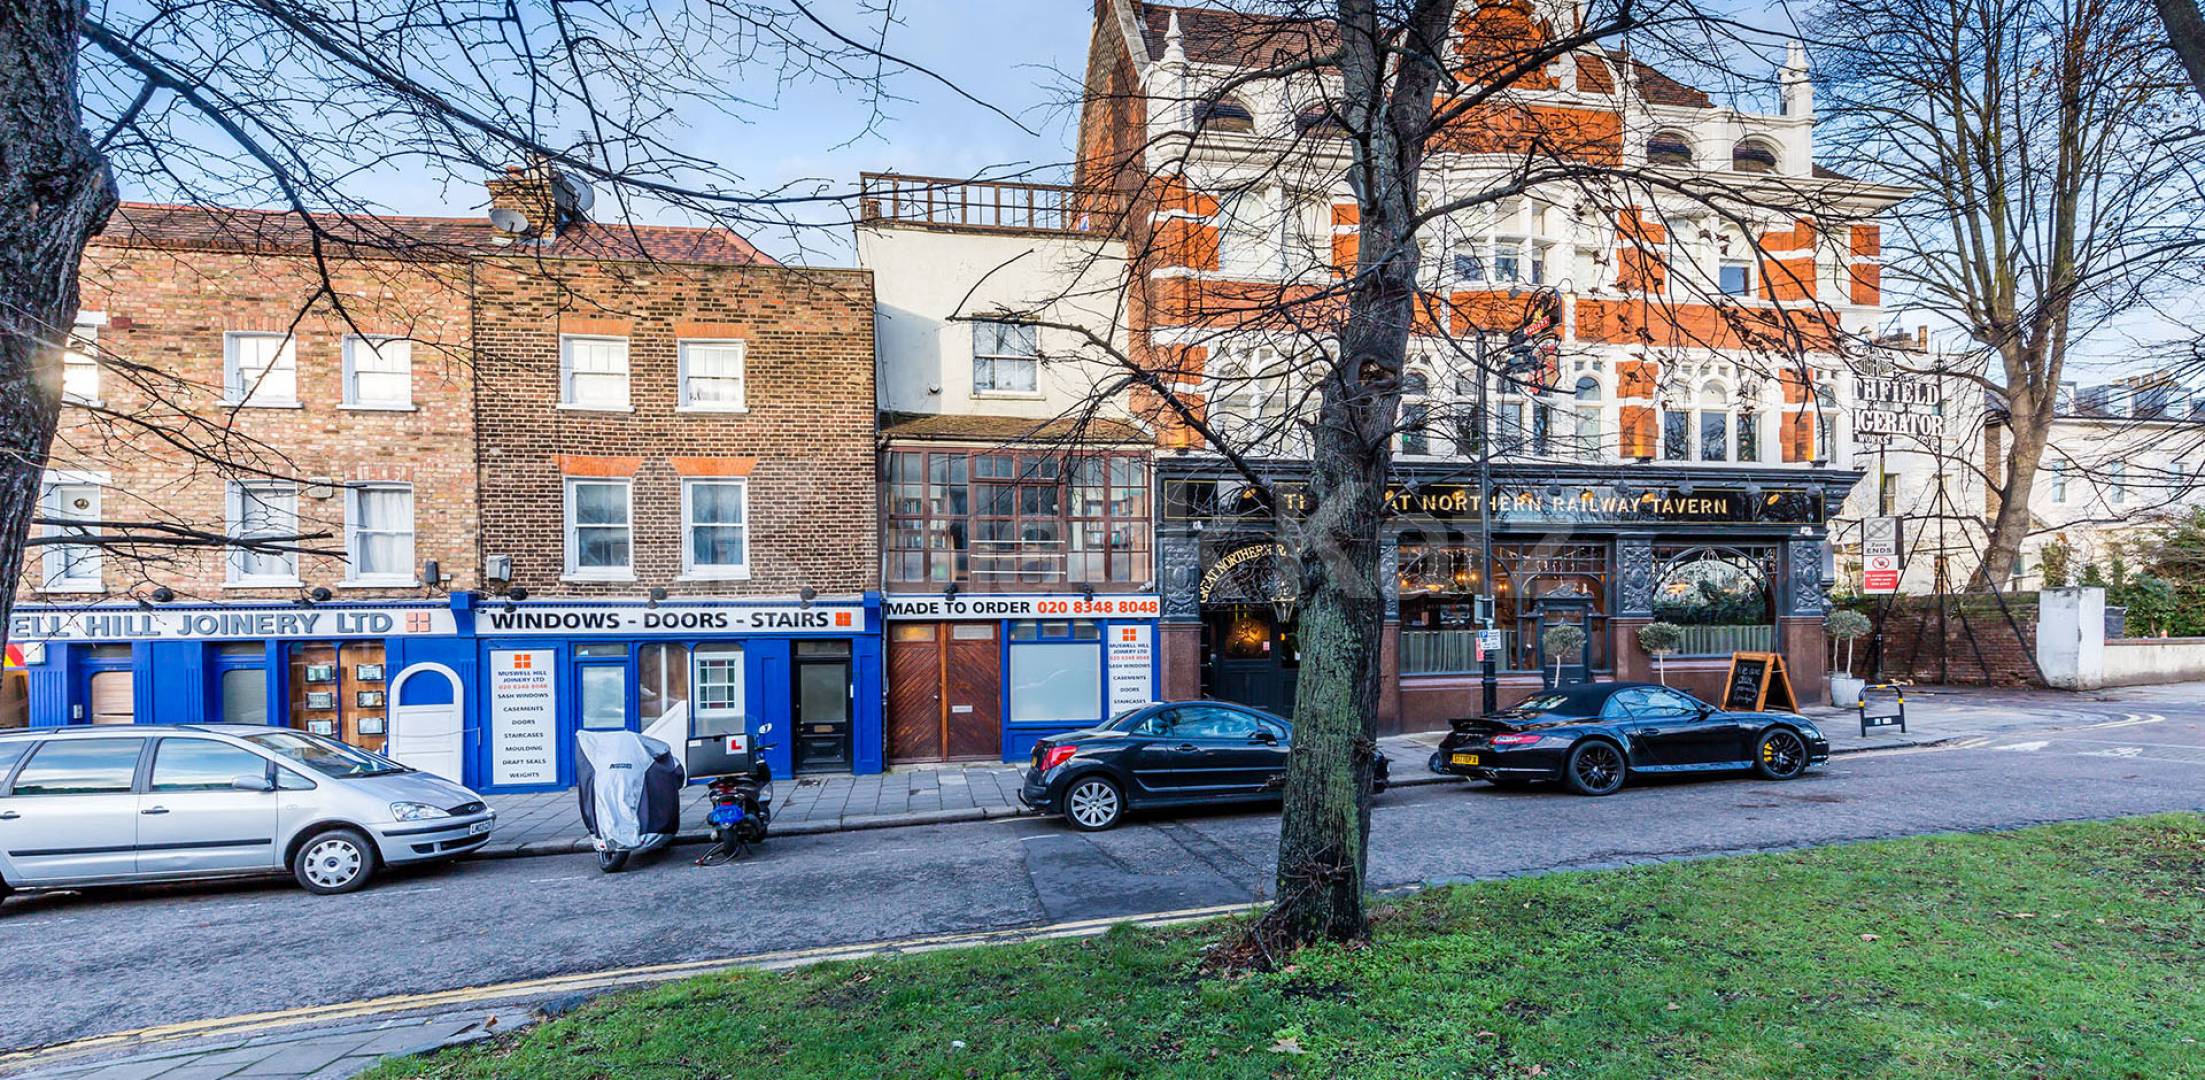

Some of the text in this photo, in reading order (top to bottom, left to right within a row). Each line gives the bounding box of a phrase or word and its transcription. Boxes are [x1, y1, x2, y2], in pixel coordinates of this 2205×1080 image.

[1858, 434, 1889, 445] WORKS
[1423, 495, 1541, 511] NORTHERN
[1552, 497, 1640, 513] RAILWAY
[1652, 498, 1727, 514] TAVERN
[887, 601, 1158, 615] MADE TO ORDER 020 8348 8048
[86, 615, 161, 637] HILL
[177, 613, 320, 635] JOINERY
[337, 612, 393, 634] LTD
[490, 613, 620, 629] WINDOWS
[644, 612, 727, 629] DOORS
[751, 612, 829, 628] STAIRS
[731, 739, 742, 750] L
